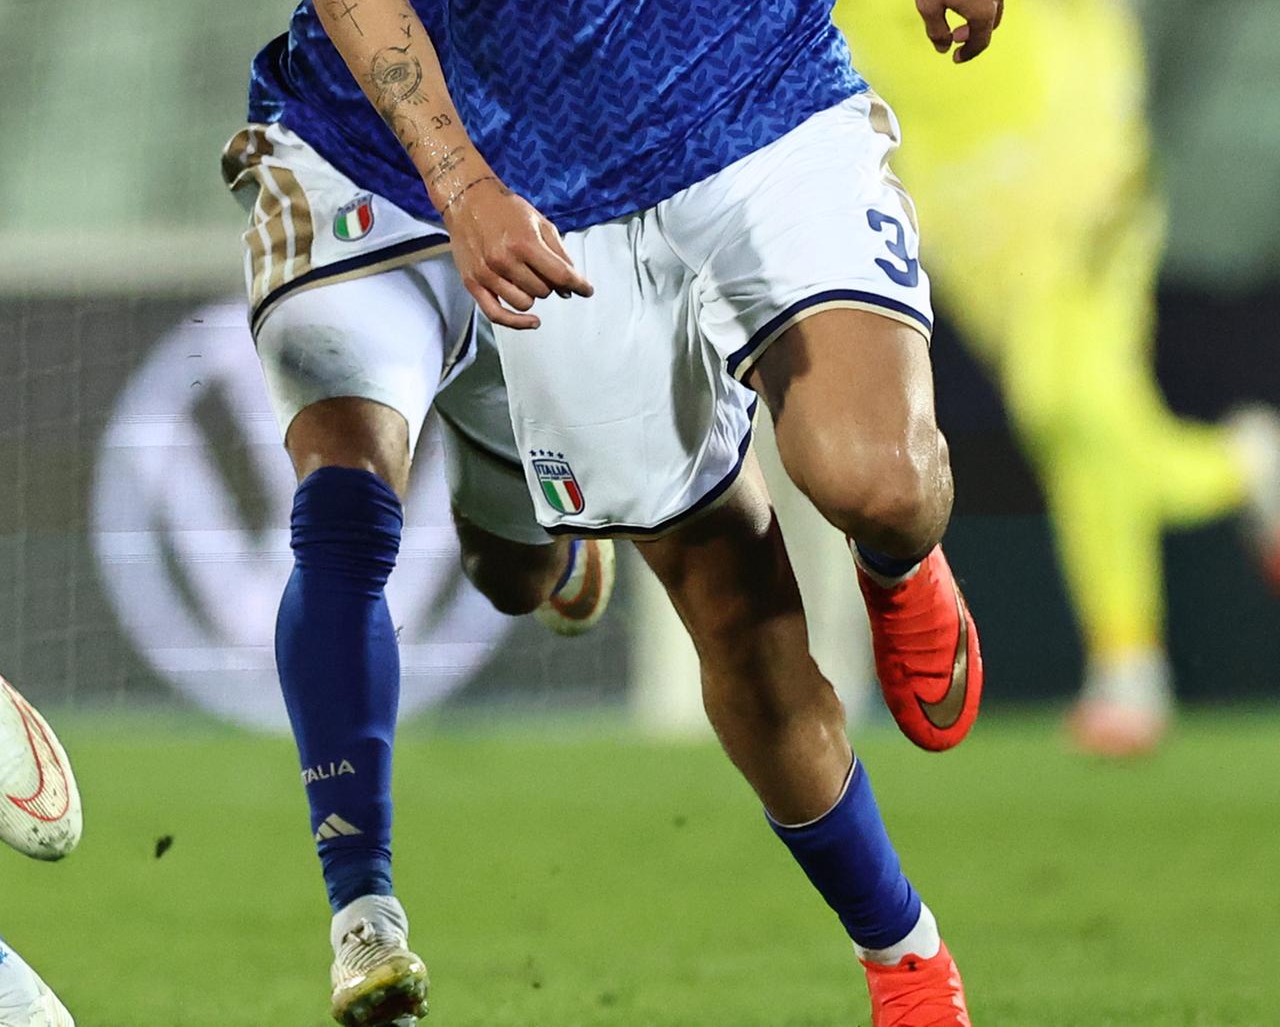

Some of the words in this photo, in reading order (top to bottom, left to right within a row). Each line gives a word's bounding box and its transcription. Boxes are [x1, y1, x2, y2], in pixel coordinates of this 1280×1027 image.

[431, 114, 452, 129] 33
[866, 208, 918, 287] 3
[536, 464, 571, 476] ITALIA
[301, 759, 356, 785] TALIA
